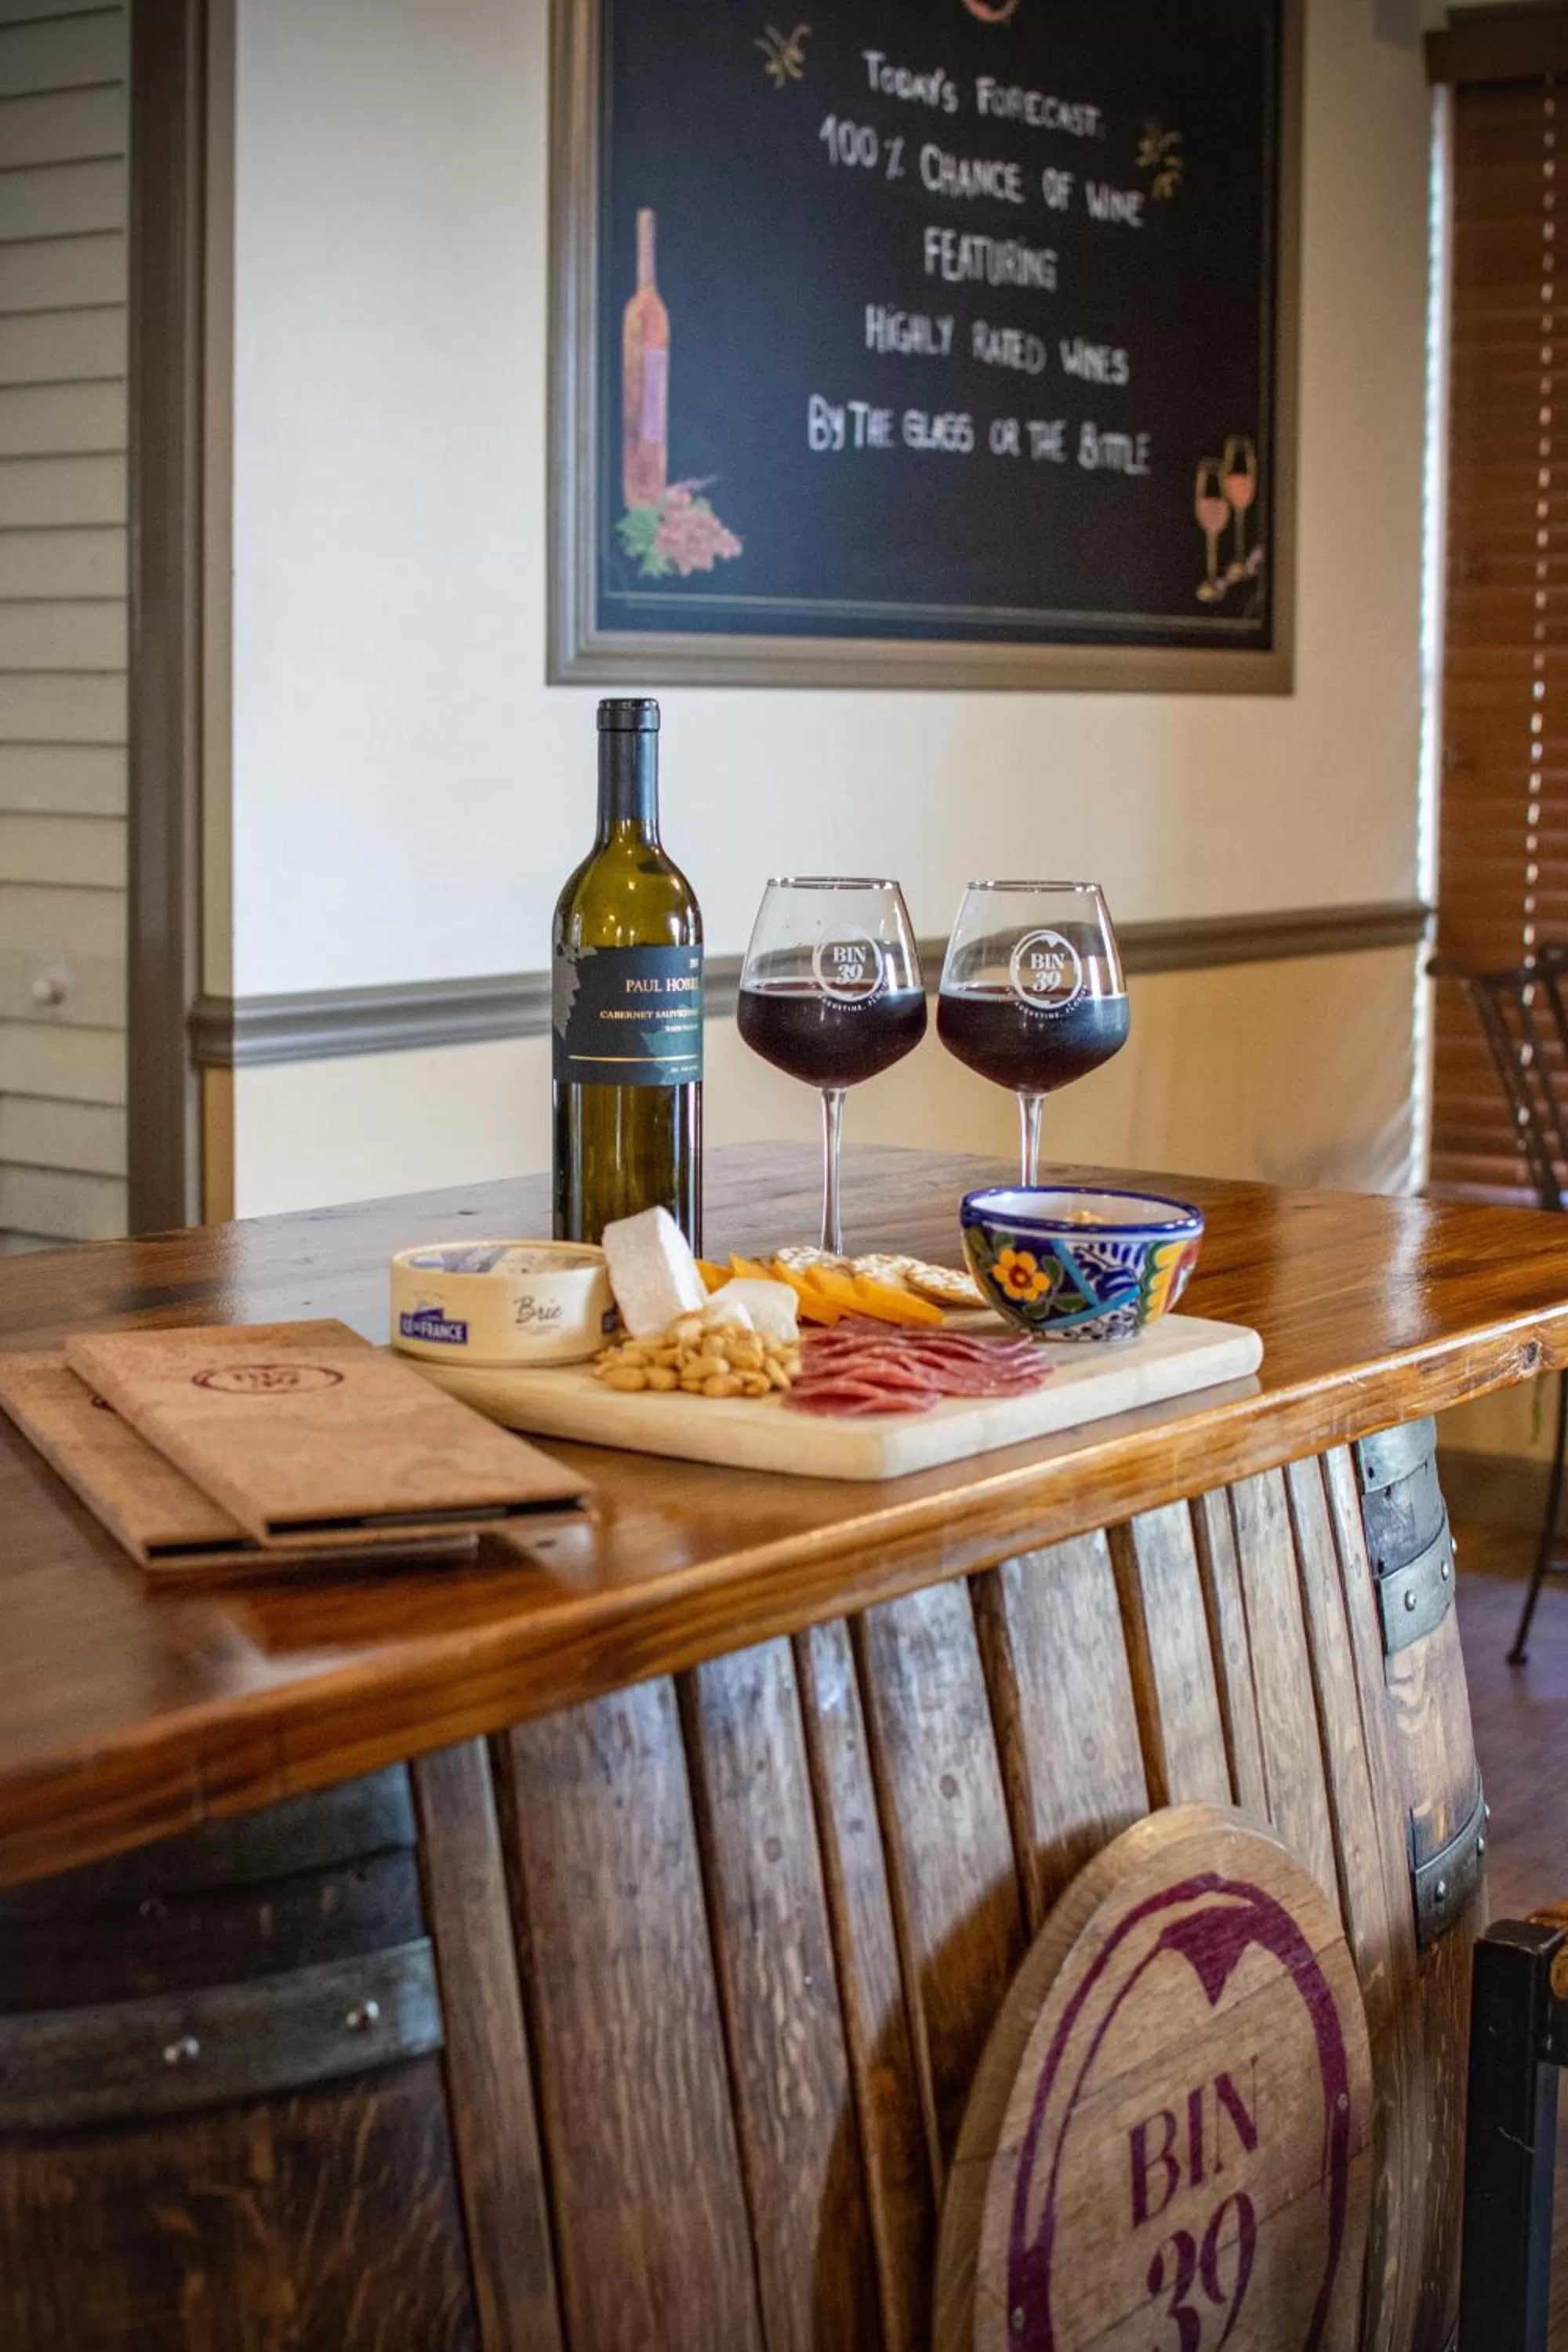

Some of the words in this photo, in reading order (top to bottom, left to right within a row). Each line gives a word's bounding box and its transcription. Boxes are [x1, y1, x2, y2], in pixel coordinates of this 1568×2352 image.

[920, 142, 1025, 203] CHANCE
[1042, 167, 1074, 210] OF
[924, 226, 1058, 292] FEATURING
[972, 320, 1047, 375] RATED
[1060, 336, 1129, 385] WINES
[833, 946, 866, 964] BIN
[1030, 953, 1065, 970] BIN
[626, 978, 662, 993] PAUL
[835, 964, 863, 985] 39
[1032, 970, 1062, 993] 39
[600, 1010, 653, 1020] CABERNET
[513, 1295, 564, 1324] Brie
[1130, 2057, 1258, 2230] BIN
[1147, 2191, 1256, 2352] 39
